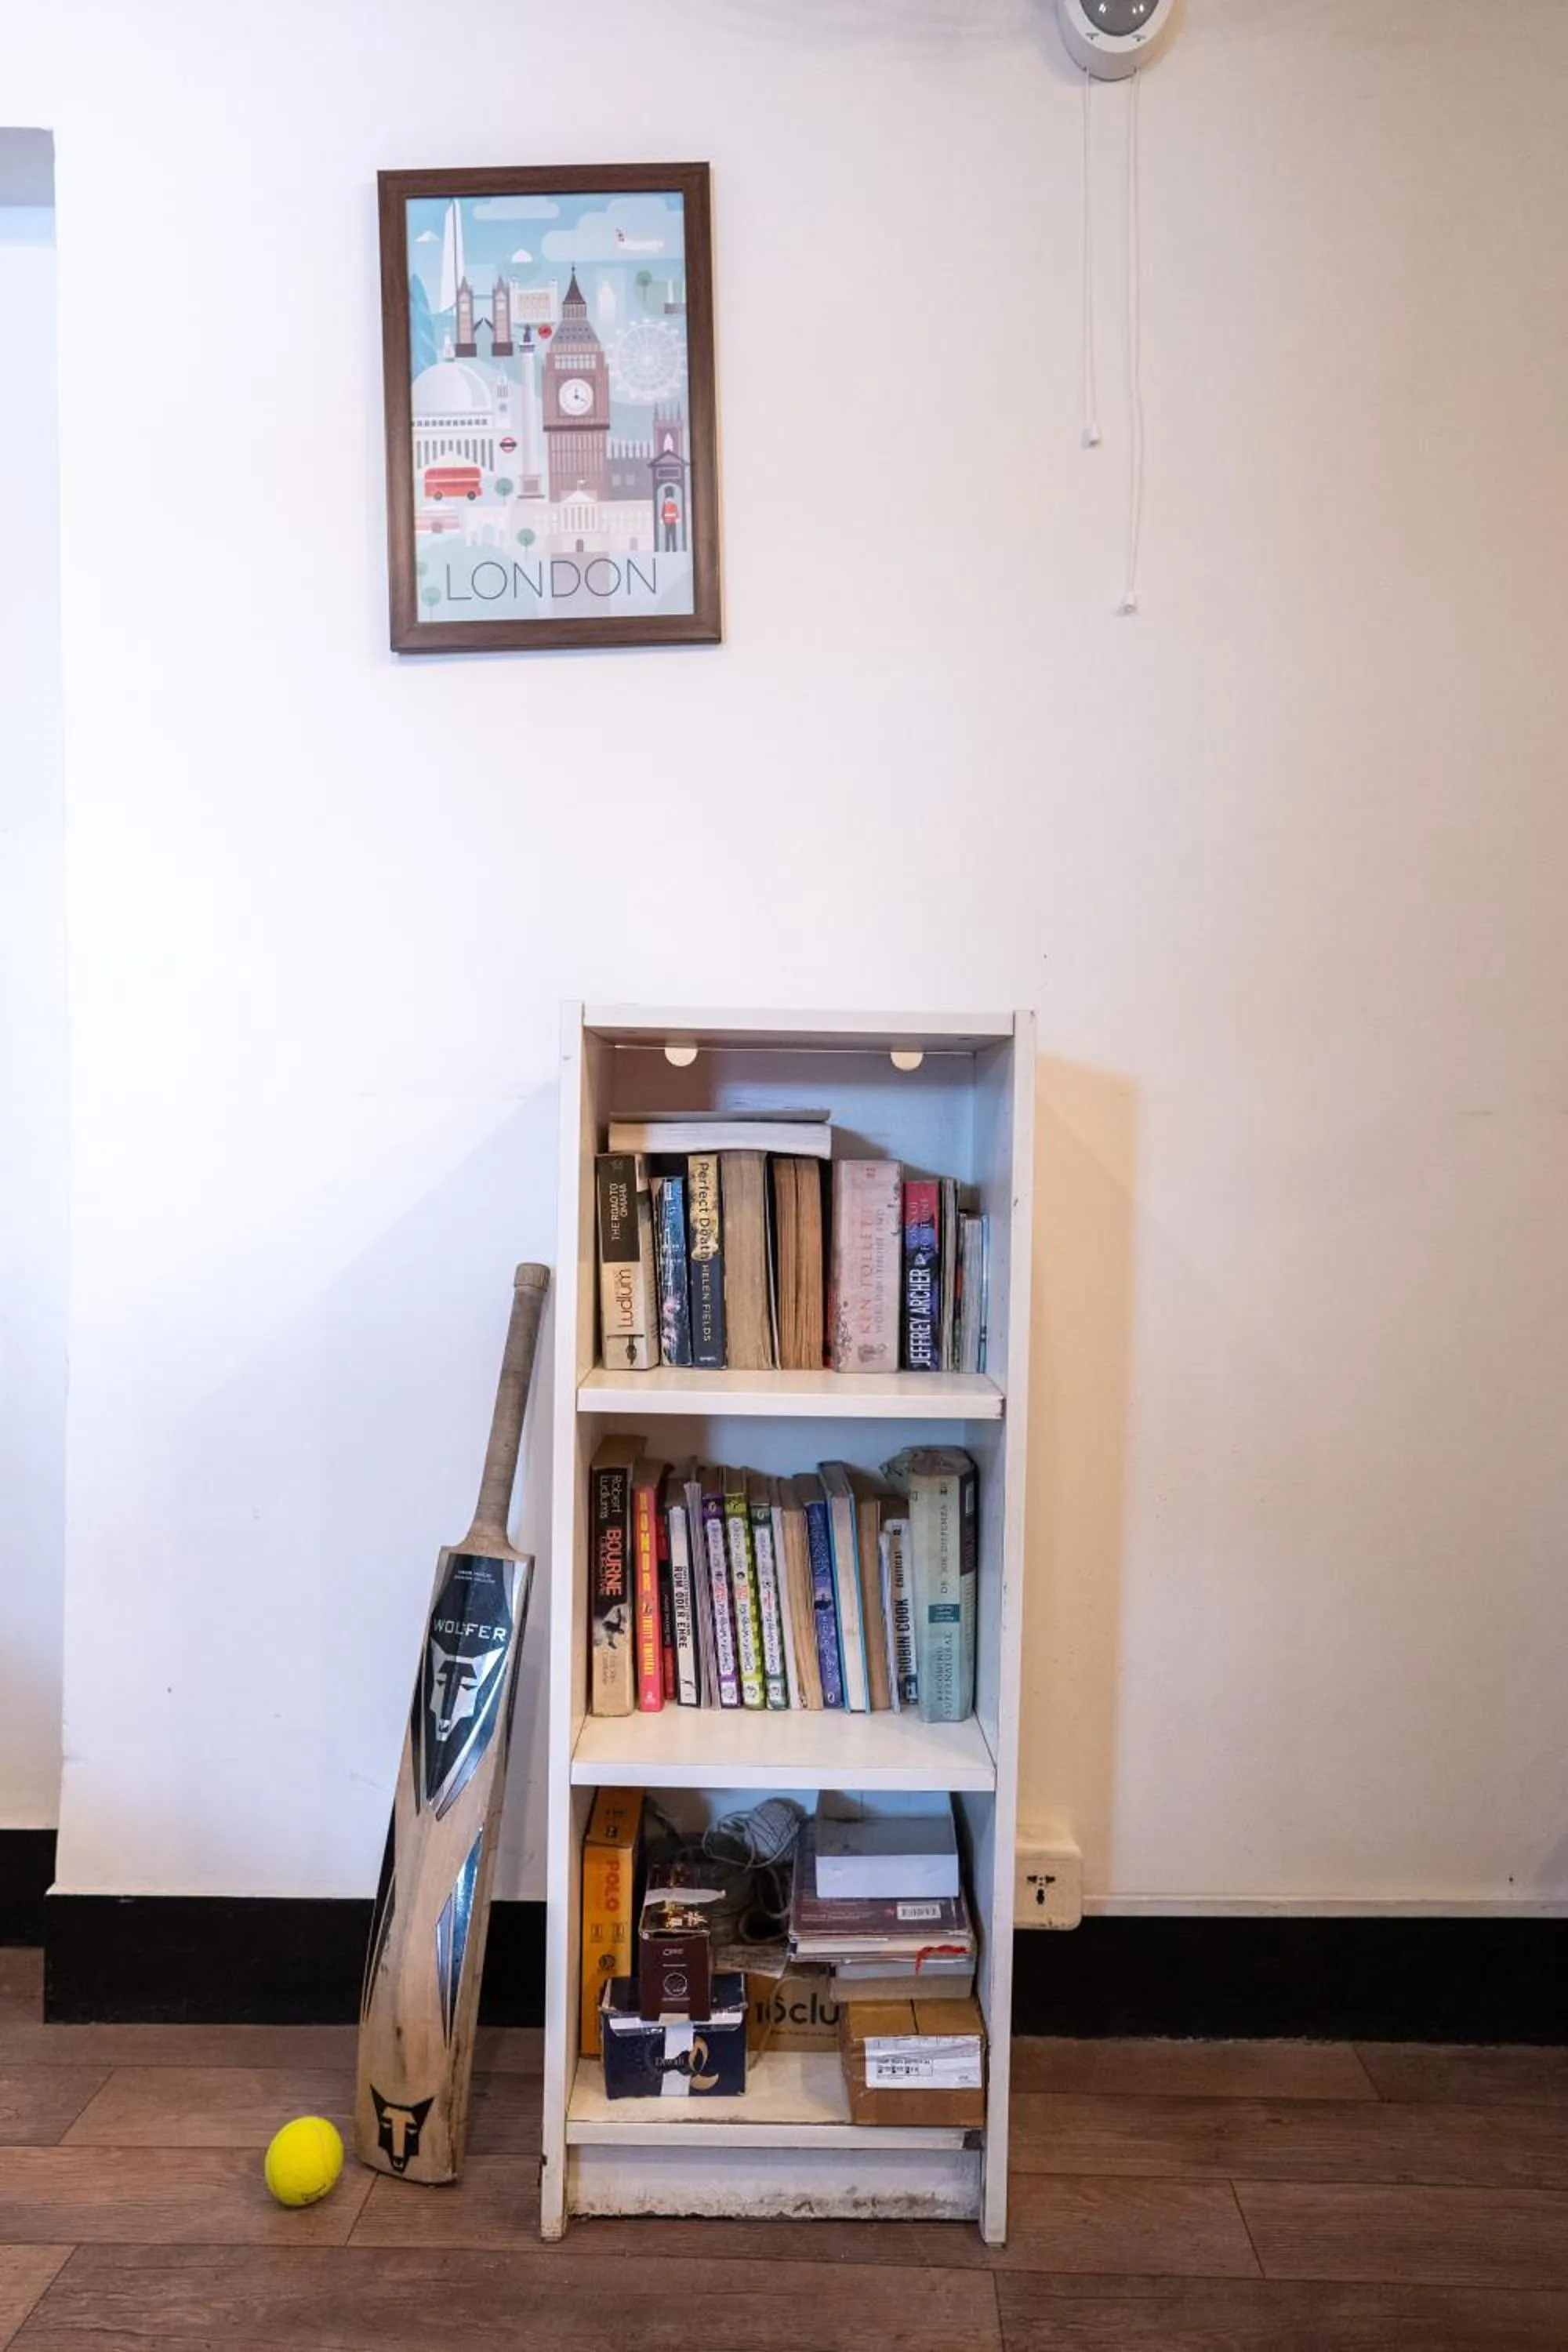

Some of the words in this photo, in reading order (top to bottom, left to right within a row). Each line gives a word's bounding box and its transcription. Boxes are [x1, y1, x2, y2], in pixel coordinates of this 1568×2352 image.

[446, 557, 658, 602] LONDON
[698, 1162, 710, 1213] Perfect
[611, 1222, 620, 1240] THE
[699, 1218, 712, 1260] Death
[616, 1268, 634, 1327] Ludlum
[702, 1265, 710, 1300] HELEN
[909, 1269, 931, 1315] ARCHER
[702, 1304, 712, 1341] FIELDS
[859, 1298, 872, 1334] KEN
[909, 1317, 931, 1367] JEFFREY
[610, 1475, 622, 1513] Robert
[605, 1527, 622, 1596] BOURNE
[674, 1566, 684, 1587] RUM
[434, 1618, 506, 1642] WOLFER
[894, 1599, 910, 1632] COOK
[677, 1622, 687, 1648] EHRE
[897, 1635, 913, 1674] ROBIN
[605, 1860, 621, 1912] POLO
